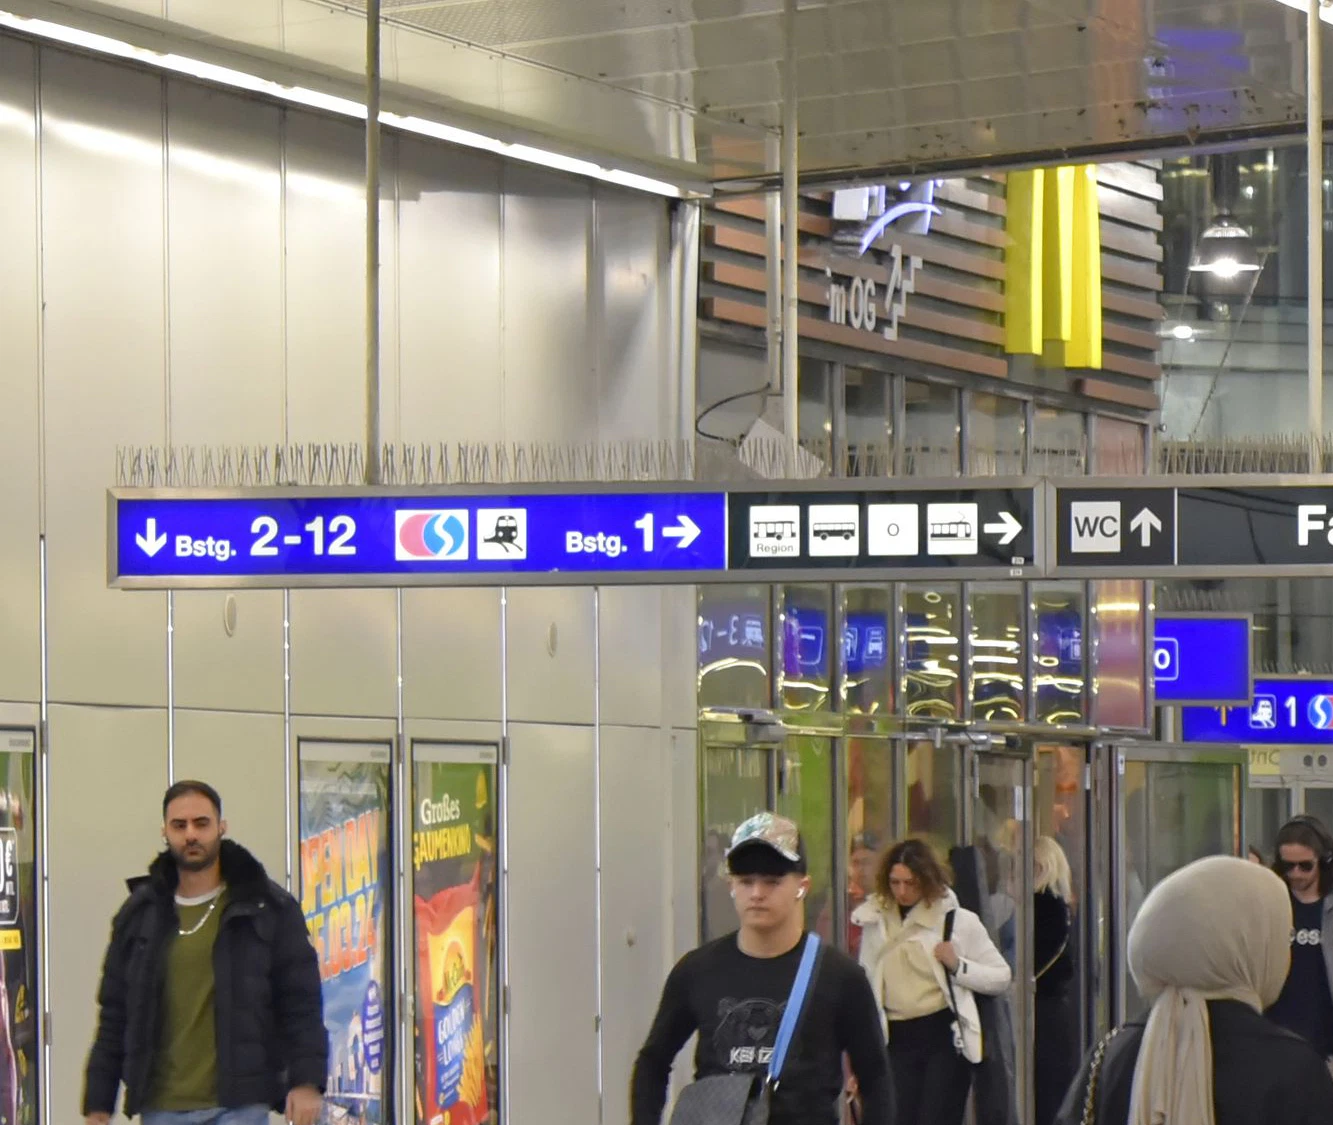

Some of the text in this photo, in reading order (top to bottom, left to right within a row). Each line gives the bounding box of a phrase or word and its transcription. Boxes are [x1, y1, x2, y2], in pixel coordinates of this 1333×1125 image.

[850, 275, 876, 333] OG
[175, 515, 357, 561] Bstg. 2-12
[565, 512, 654, 557] Bstg. 1
[1074, 516, 1118, 538] WC
[756, 543, 794, 555] Region
[1284, 696, 1297, 727] 1
[420, 793, 460, 825] Großes
[343, 807, 379, 893] DAY
